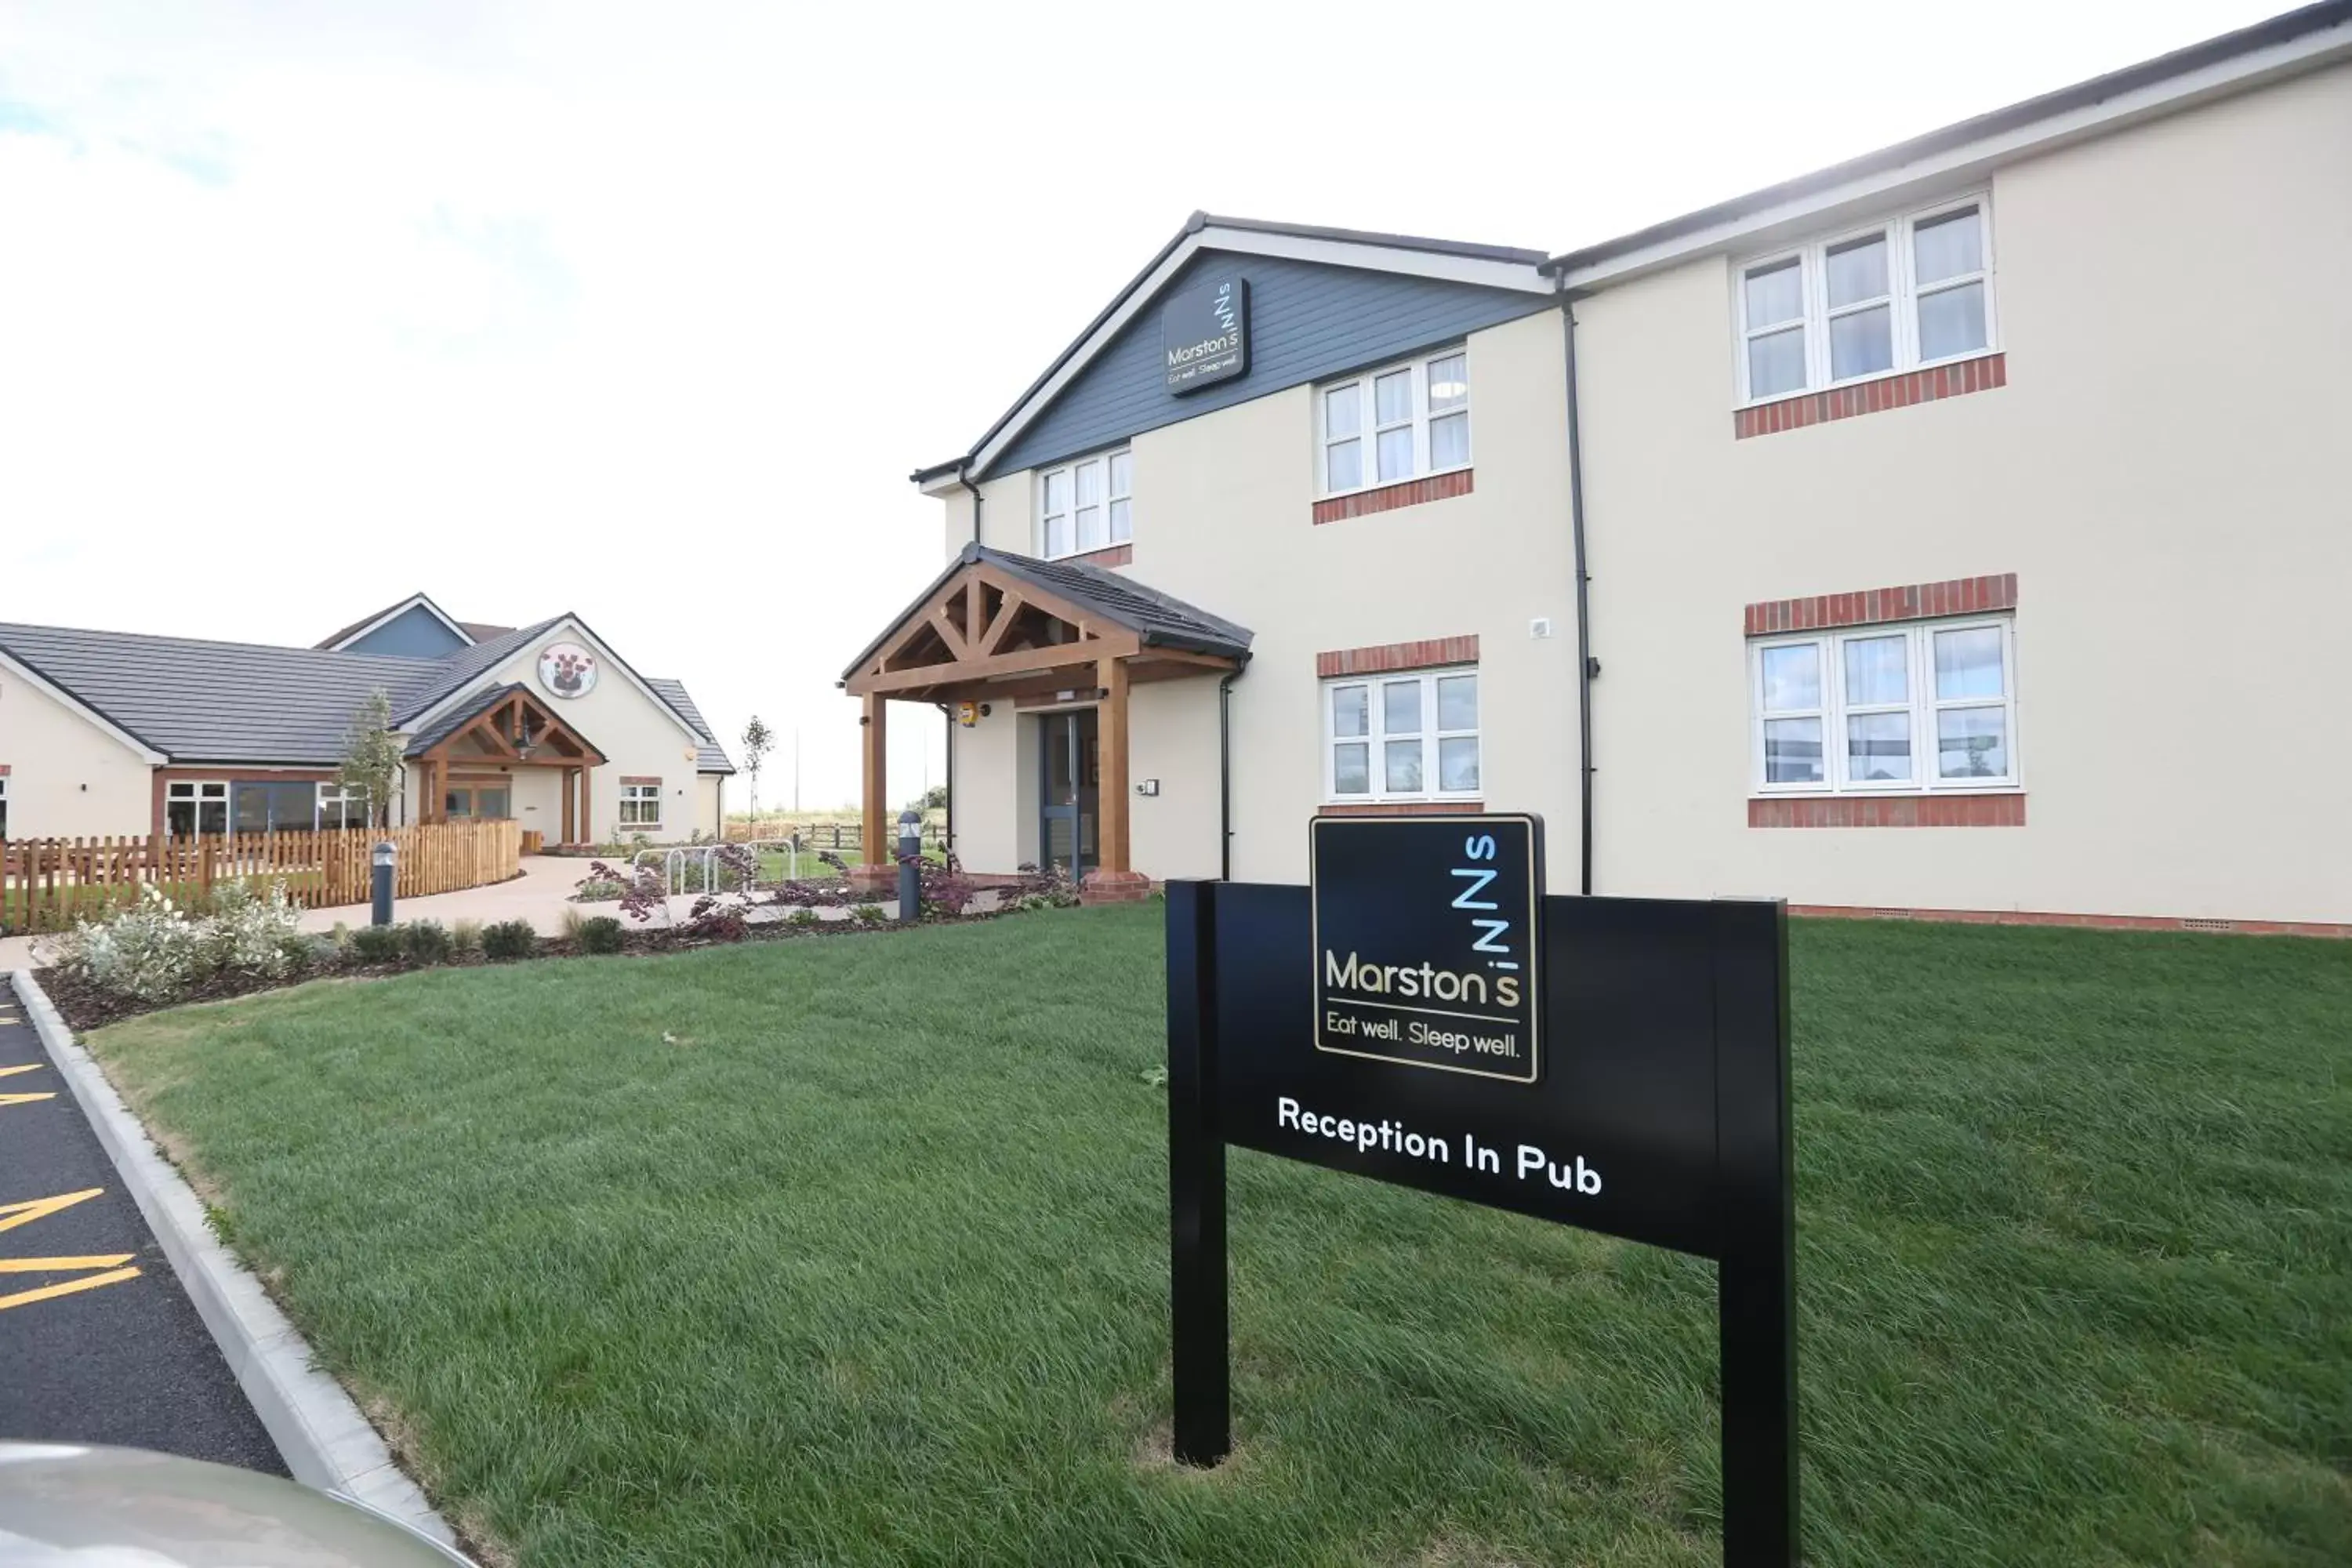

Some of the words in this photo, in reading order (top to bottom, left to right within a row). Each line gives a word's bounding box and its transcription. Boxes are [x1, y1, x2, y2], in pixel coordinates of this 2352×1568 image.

[1327, 1011, 1357, 1035] Eat
[1362, 1019, 1403, 1041] well.
[1409, 1022, 1470, 1054] Sleep
[1473, 1034, 1521, 1058] well.
[1279, 1097, 1449, 1163] Reception
[1465, 1134, 1500, 1174] In
[1517, 1144, 1602, 1195] Pub
